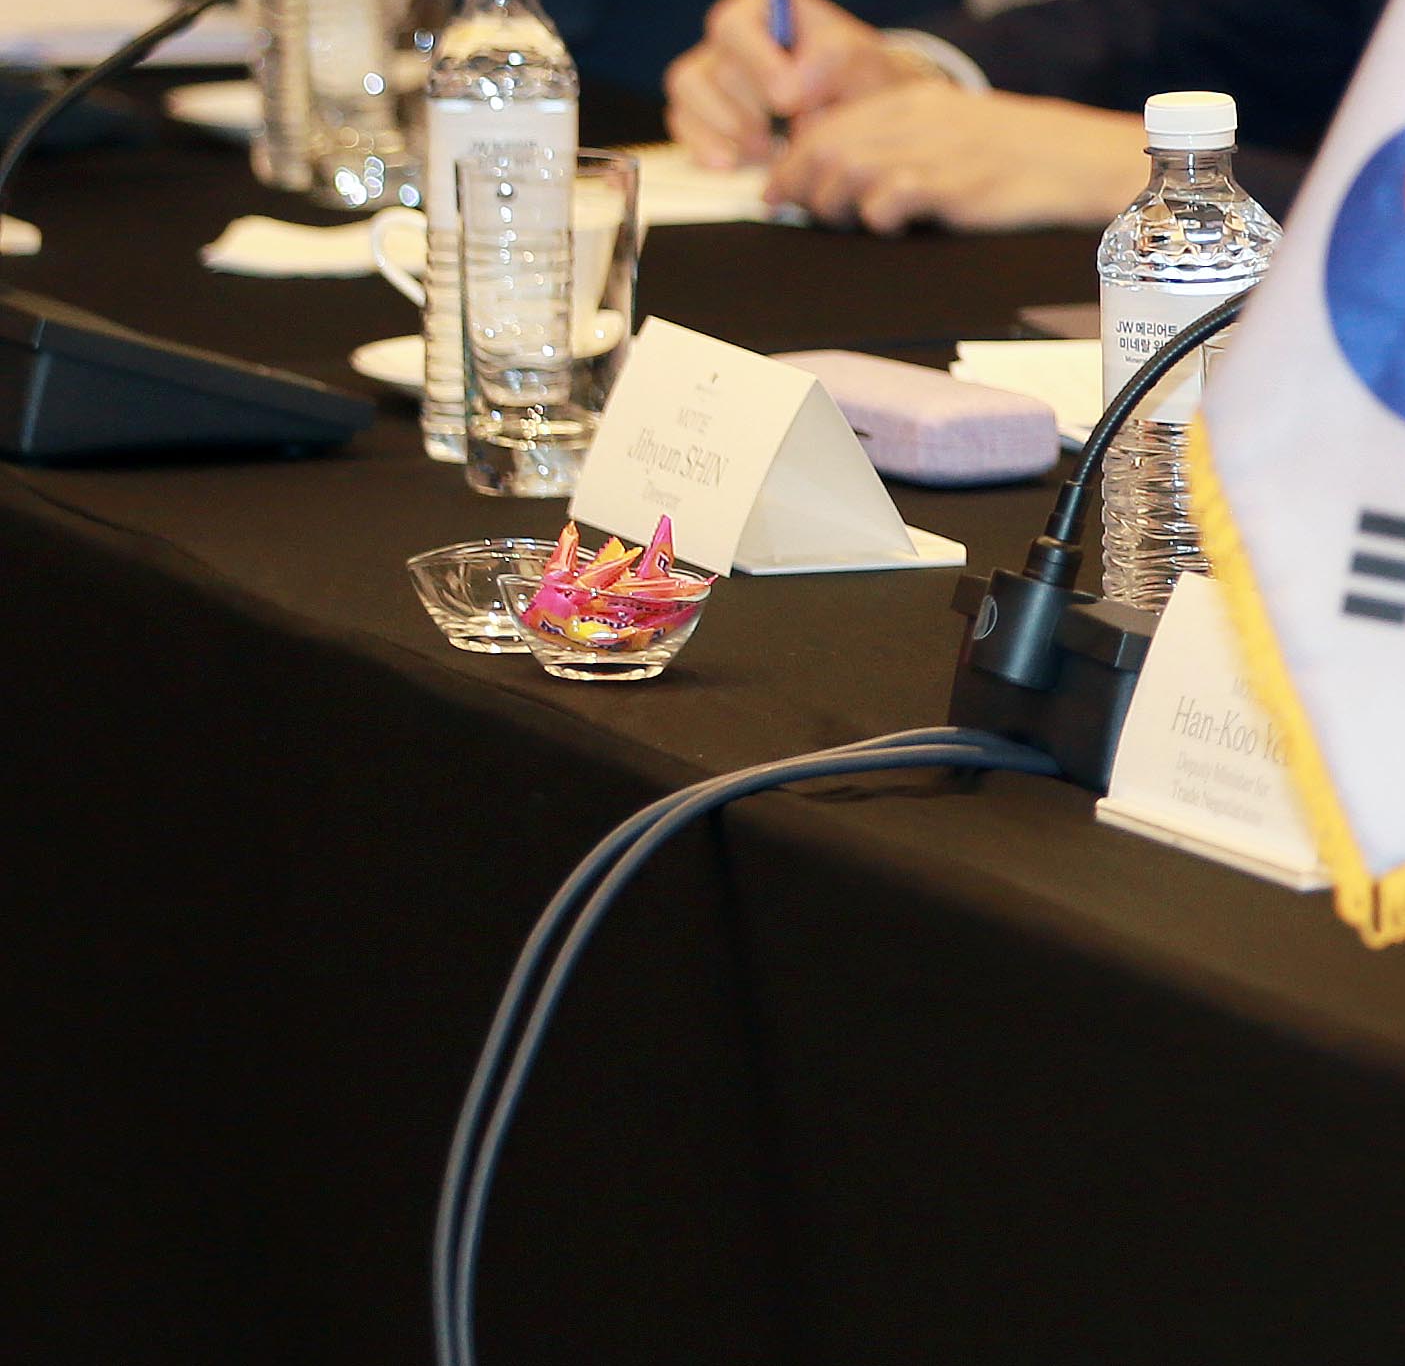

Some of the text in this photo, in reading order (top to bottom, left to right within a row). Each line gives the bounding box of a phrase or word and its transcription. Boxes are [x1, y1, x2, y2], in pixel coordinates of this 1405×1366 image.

[1116, 321, 1178, 337] JW 메리어트
[1120, 337, 1150, 353] 미네랄
[680, 444, 730, 488] SHIN
[1171, 695, 1257, 755] Han-Koo
